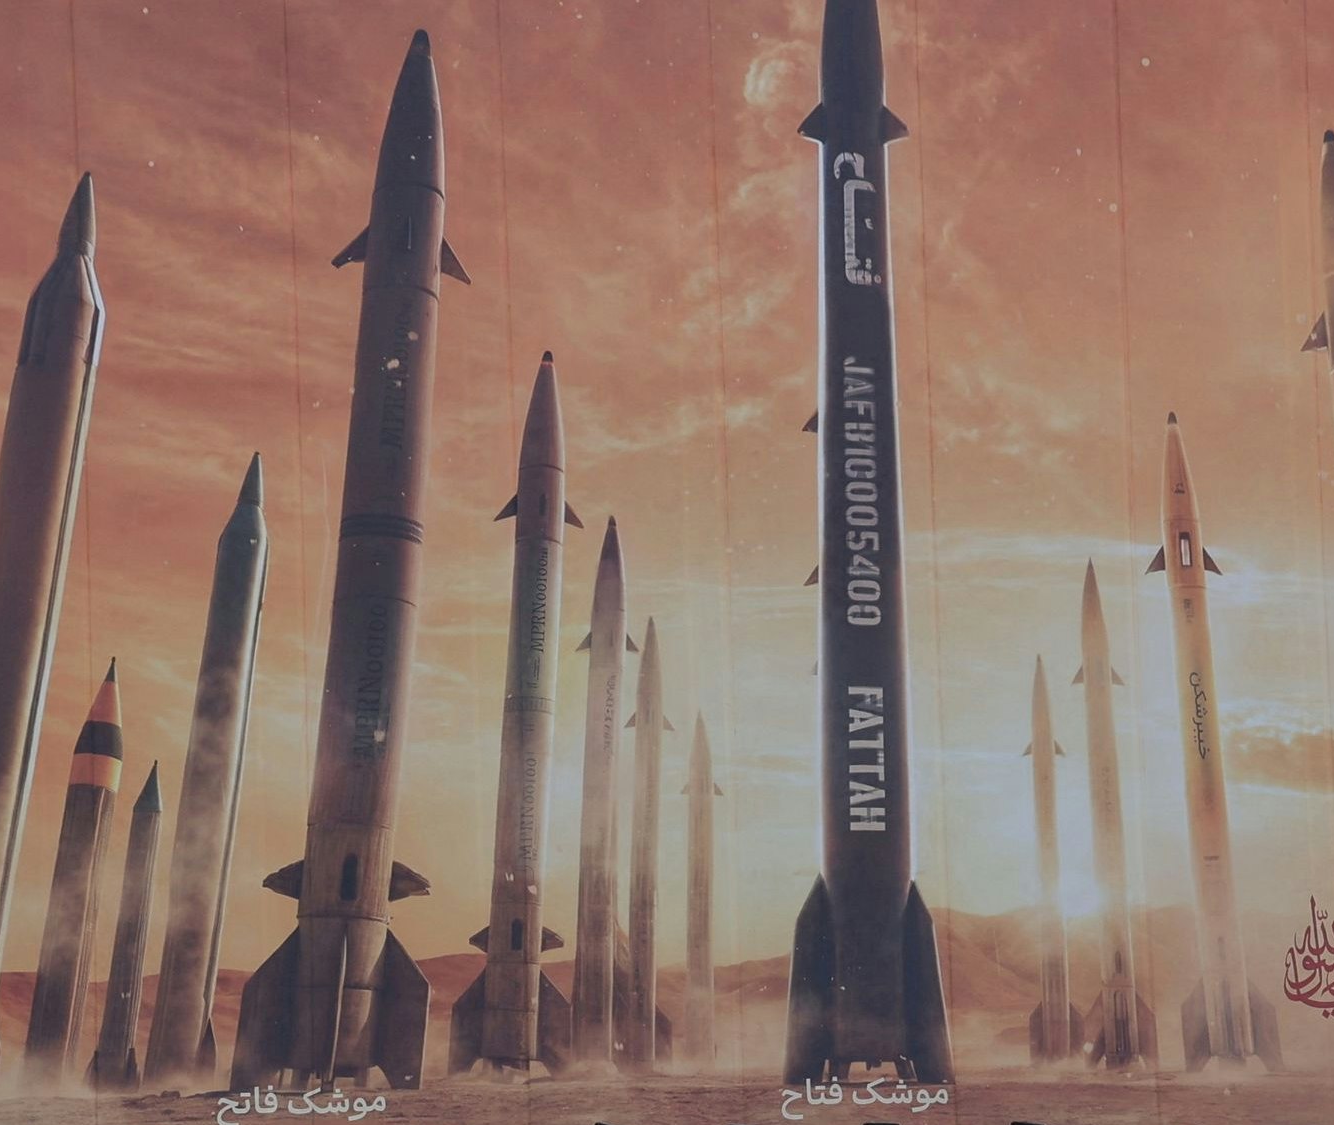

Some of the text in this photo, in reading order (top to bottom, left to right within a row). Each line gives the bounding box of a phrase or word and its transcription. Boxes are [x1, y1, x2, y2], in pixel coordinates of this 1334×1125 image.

[848, 685, 887, 832] FATTAH
[288, 1086, 387, 1122] موشک
[778, 1077, 949, 1121] موشک فتاح
